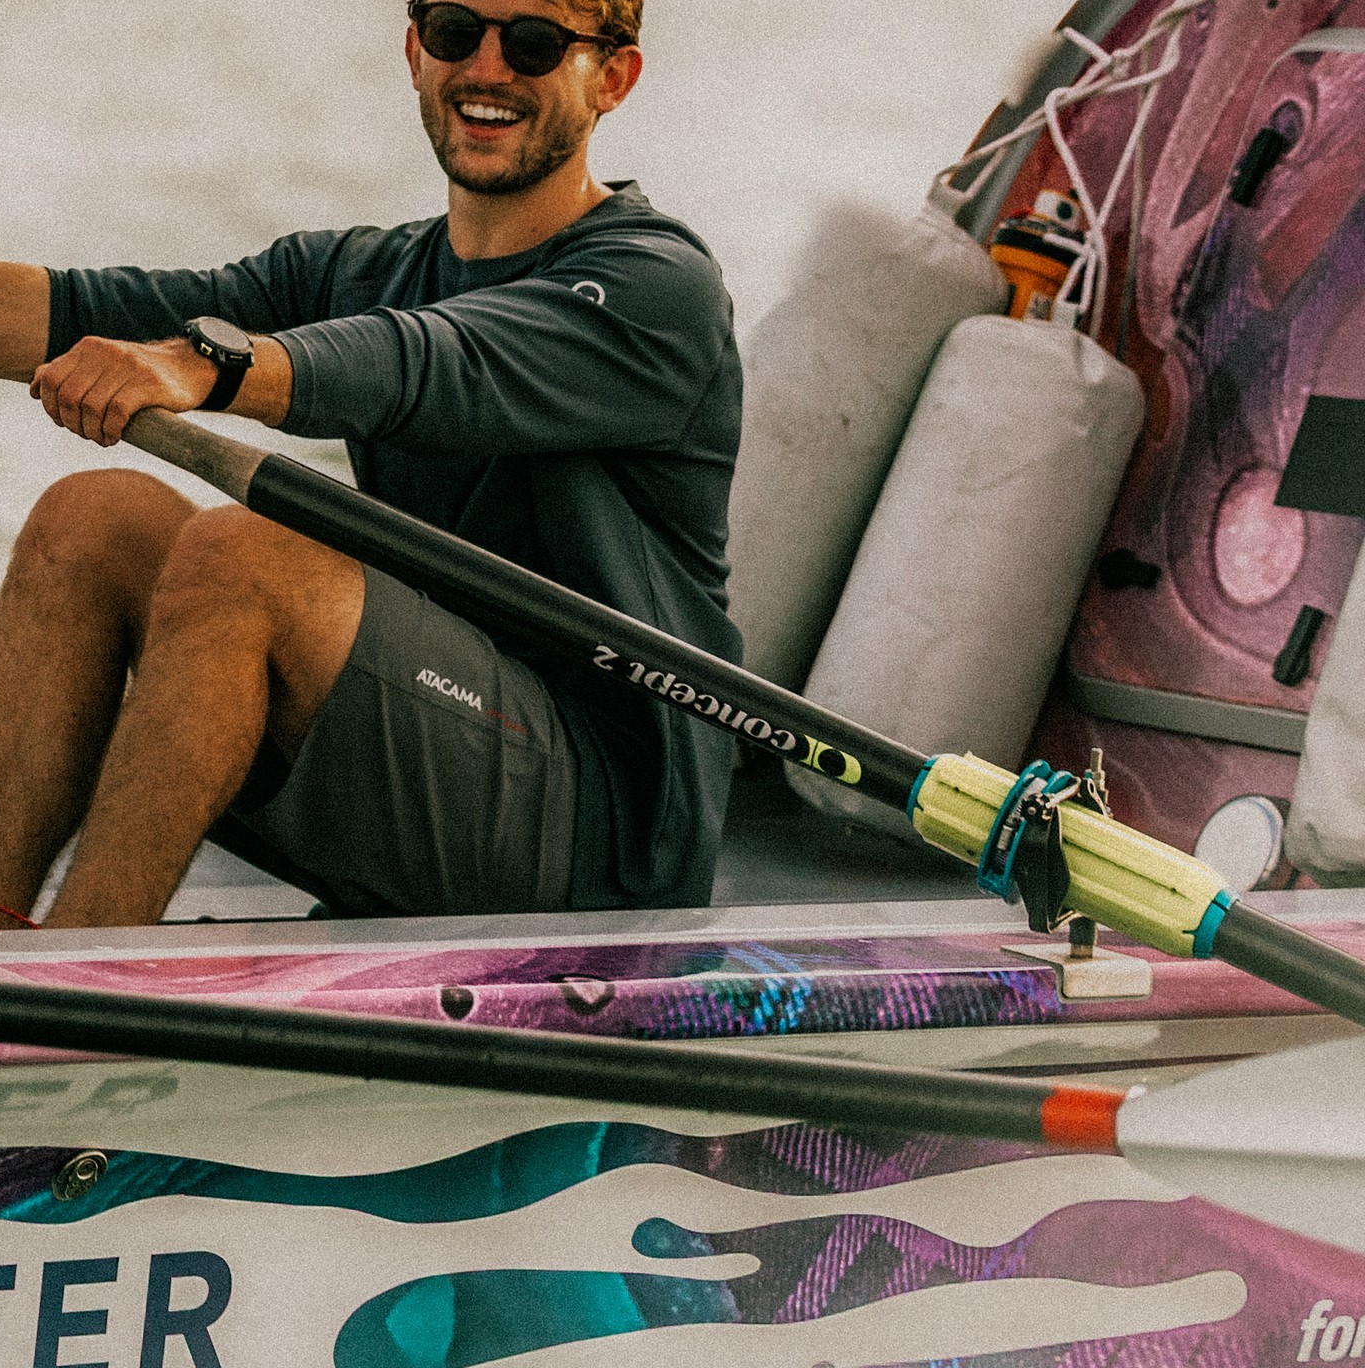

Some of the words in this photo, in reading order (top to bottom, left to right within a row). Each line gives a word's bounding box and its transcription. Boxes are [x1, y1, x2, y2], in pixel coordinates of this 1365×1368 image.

[592, 644, 620, 672] 2
[416, 668, 482, 712] ATACAMA
[630, 661, 797, 751] concept
